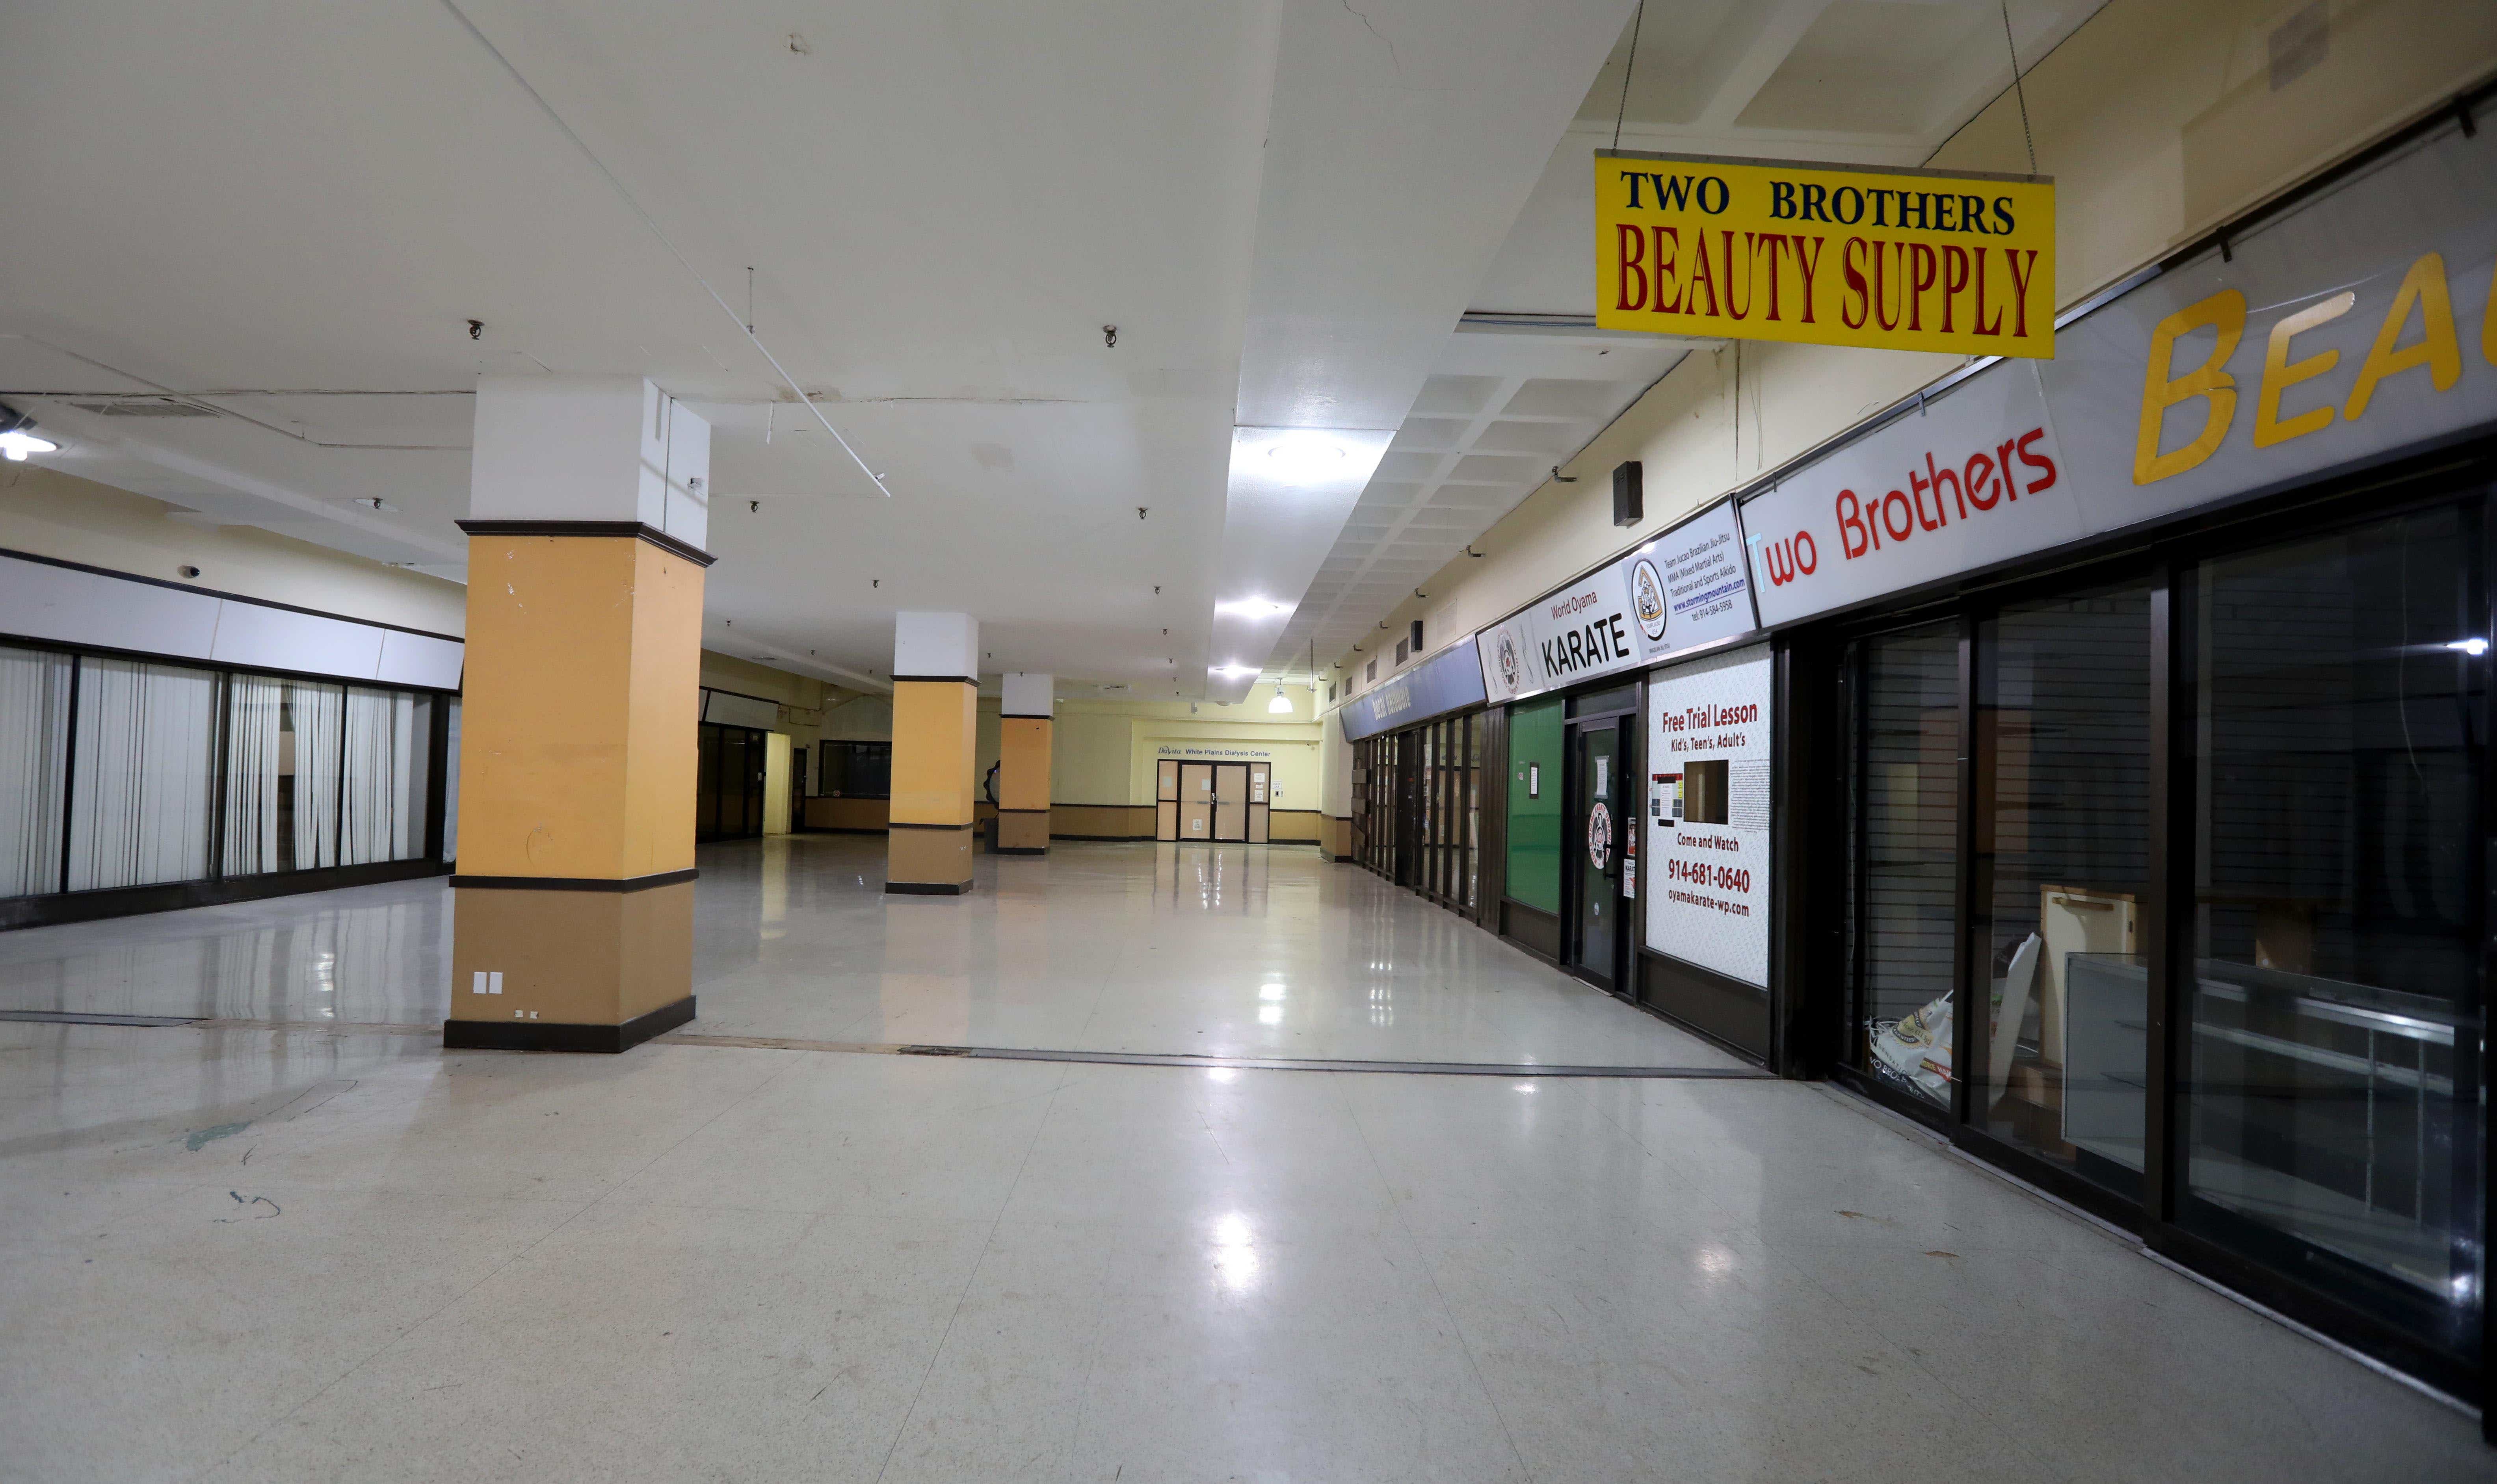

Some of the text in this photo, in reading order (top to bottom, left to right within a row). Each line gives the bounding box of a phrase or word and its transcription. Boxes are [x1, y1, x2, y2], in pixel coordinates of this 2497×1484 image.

[1620, 171, 2015, 235] TWO BROTHERS
[1615, 223, 2038, 338] BEAUTY SUPPLY
[2132, 252, 2497, 486] BEA
[1746, 427, 2057, 592] Two Brothers
[1664, 533, 1730, 569] Team Jucao Brazilian Jiu-Jitsu
[1668, 551, 1725, 583] MMA (Mixed Martial Arts)
[1670, 564, 1736, 598] Traditional and Sports Aikido
[1673, 578, 1745, 611] www.stormingmountain.com
[1551, 592, 1597, 620] World Oyama
[1699, 599, 1733, 619] 914-584-5958
[1541, 613, 1630, 678] KARATE
[1662, 704, 1757, 733] Free Trial Lesson
[1158, 746, 1181, 755] DaVita
[1671, 732, 1746, 752] Kid's, Teen's, Adult's
[1677, 832, 1739, 852] Come and Watch
[1669, 859, 1750, 893] 914-681-0640
[1669, 889, 1749, 917] oyamakarate-wp.com
